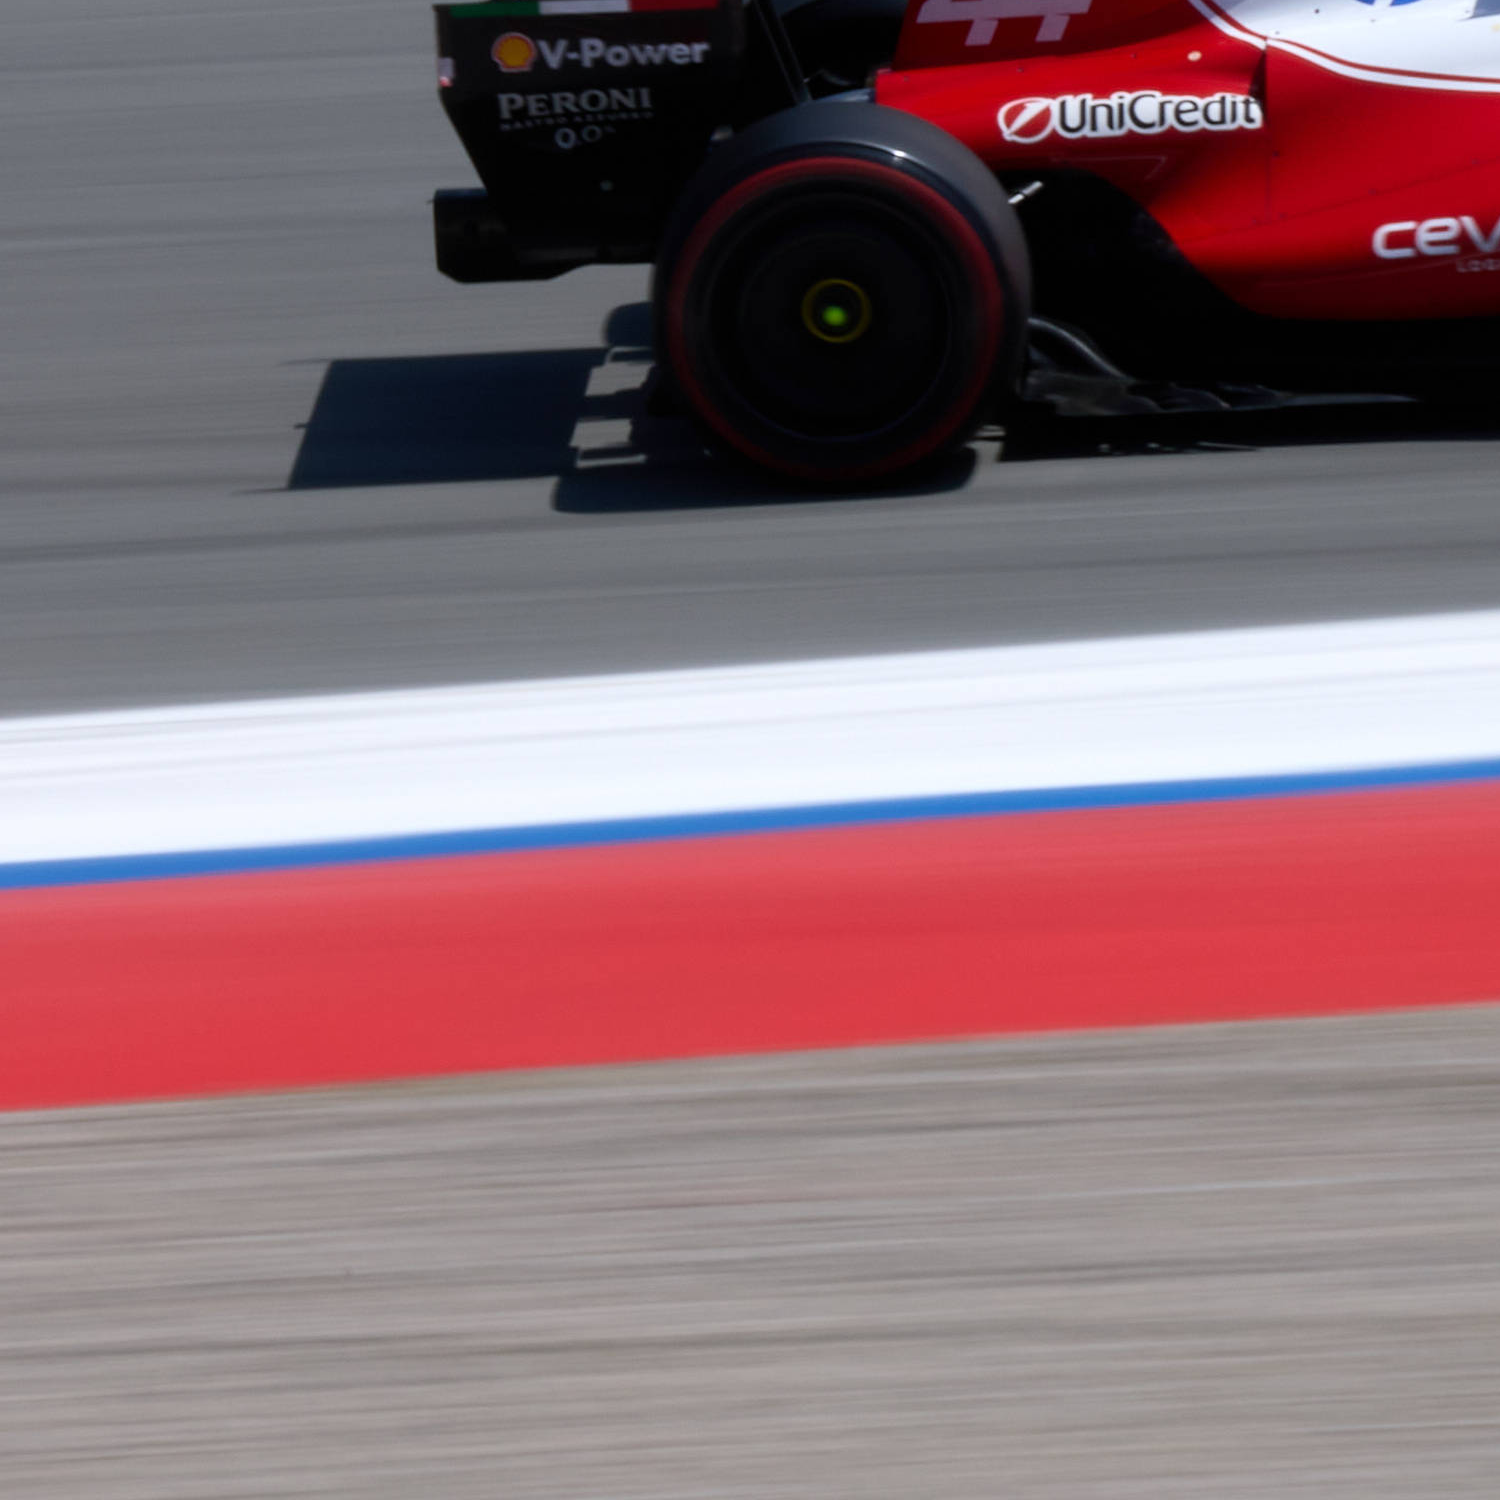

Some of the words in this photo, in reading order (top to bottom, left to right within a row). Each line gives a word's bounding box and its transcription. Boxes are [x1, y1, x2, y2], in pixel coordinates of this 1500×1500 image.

[536, 37, 711, 70] V-Power
[497, 86, 654, 120] PERONI
[1058, 93, 1260, 134] UniCredit
